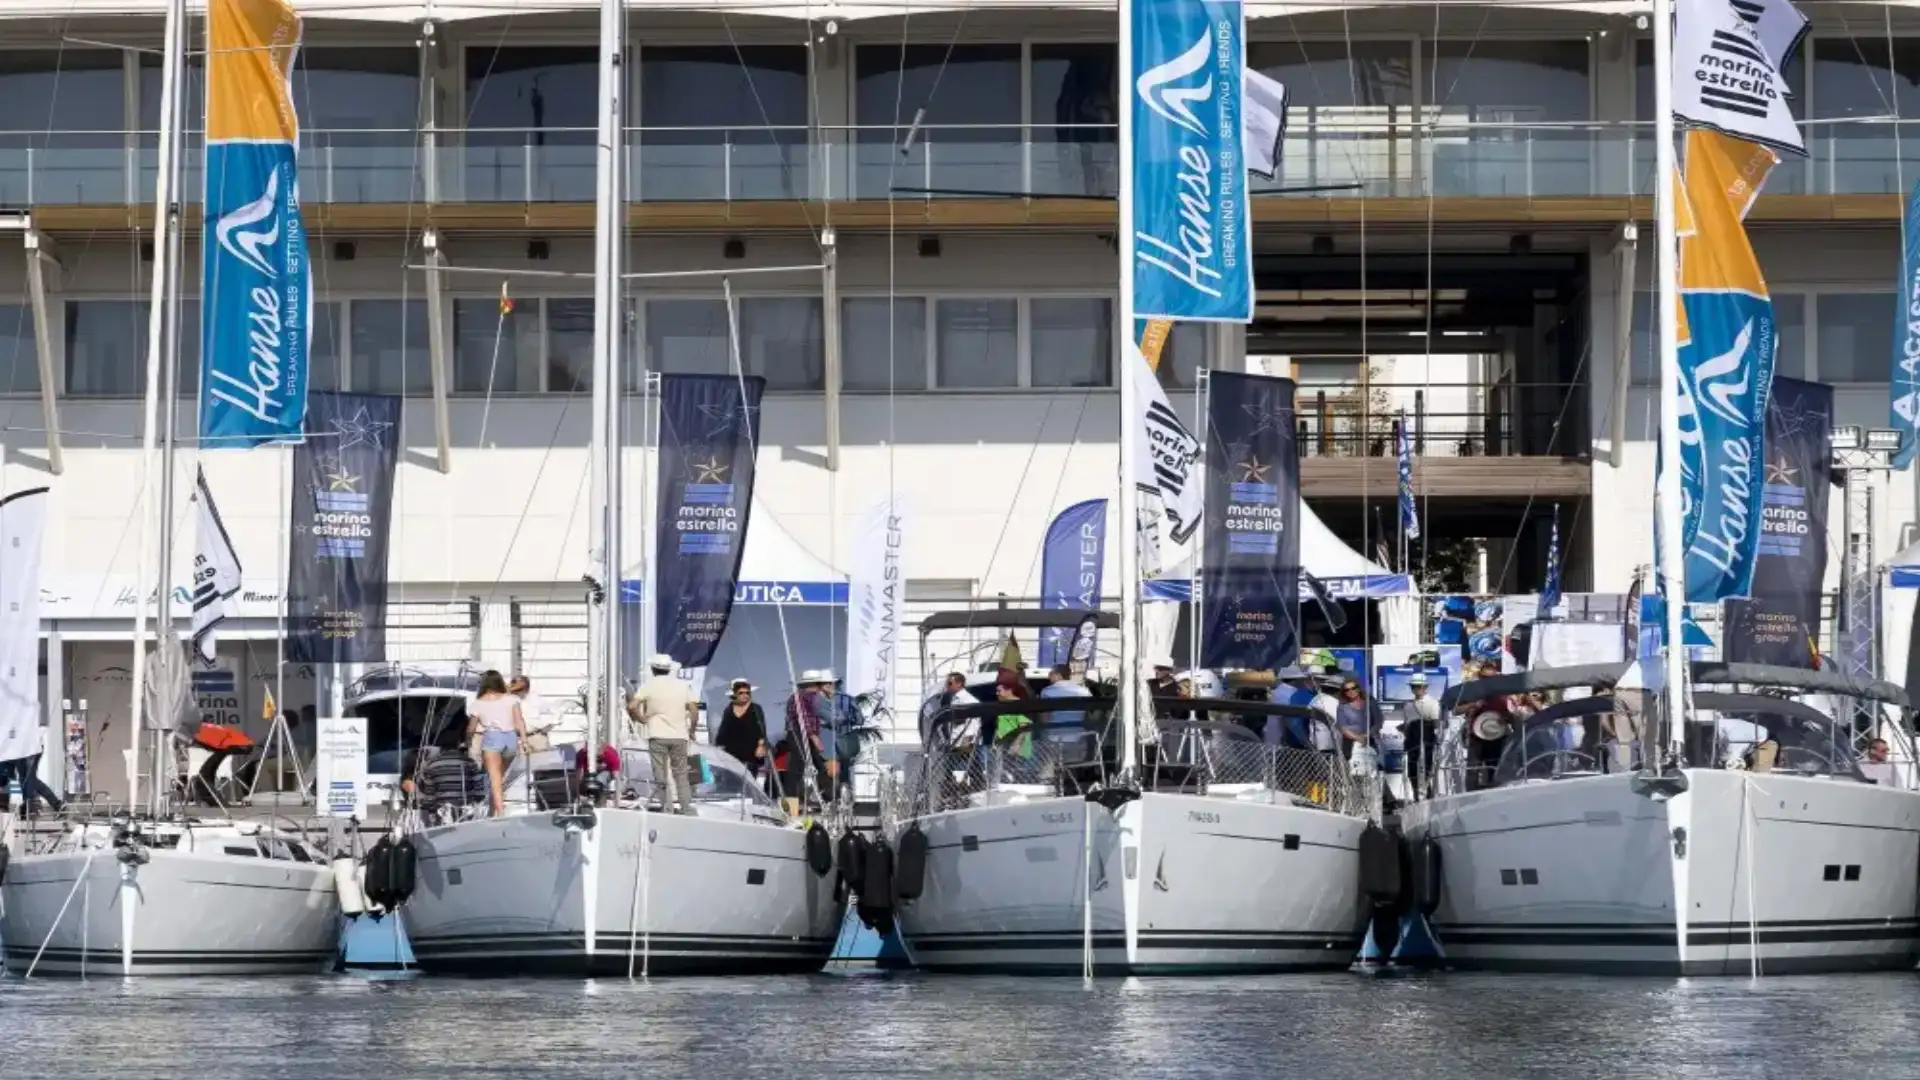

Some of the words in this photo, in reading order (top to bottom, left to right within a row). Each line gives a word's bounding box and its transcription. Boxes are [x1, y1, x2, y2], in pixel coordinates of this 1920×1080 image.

[1699, 53, 1774, 84] marina
[1695, 69, 1778, 100] estrella
[1221, 151, 1233, 195] RULES
[1136, 144, 1222, 298] Hanse
[1223, 199, 1236, 267] BREAKING
[287, 219, 300, 274] SETTING
[284, 285, 299, 329] RULES
[1758, 317, 1771, 365] TRENDS
[210, 285, 281, 424] Hanse
[285, 331, 299, 396] BREAKING
[679, 504, 736, 518] marina
[1228, 504, 1282, 518] marina
[1689, 436, 1751, 580] Hanse
[1763, 506, 1808, 521] arina
[312, 524, 372, 537] estrella
[676, 517, 738, 532] estrella
[1225, 517, 1284, 532] estrella
[1763, 519, 1809, 534] trella
[1078, 522, 1098, 608] ASTER
[734, 585, 804, 602] UTICA
[1298, 578, 1361, 595] SEM
[1755, 612, 1797, 622] marina
[1235, 621, 1275, 632] estrella
[1755, 622, 1799, 633] estrella
[685, 631, 719, 642] group
[1754, 633, 1789, 644] group
[198, 694, 238, 709] rina
[200, 710, 240, 725] ella
